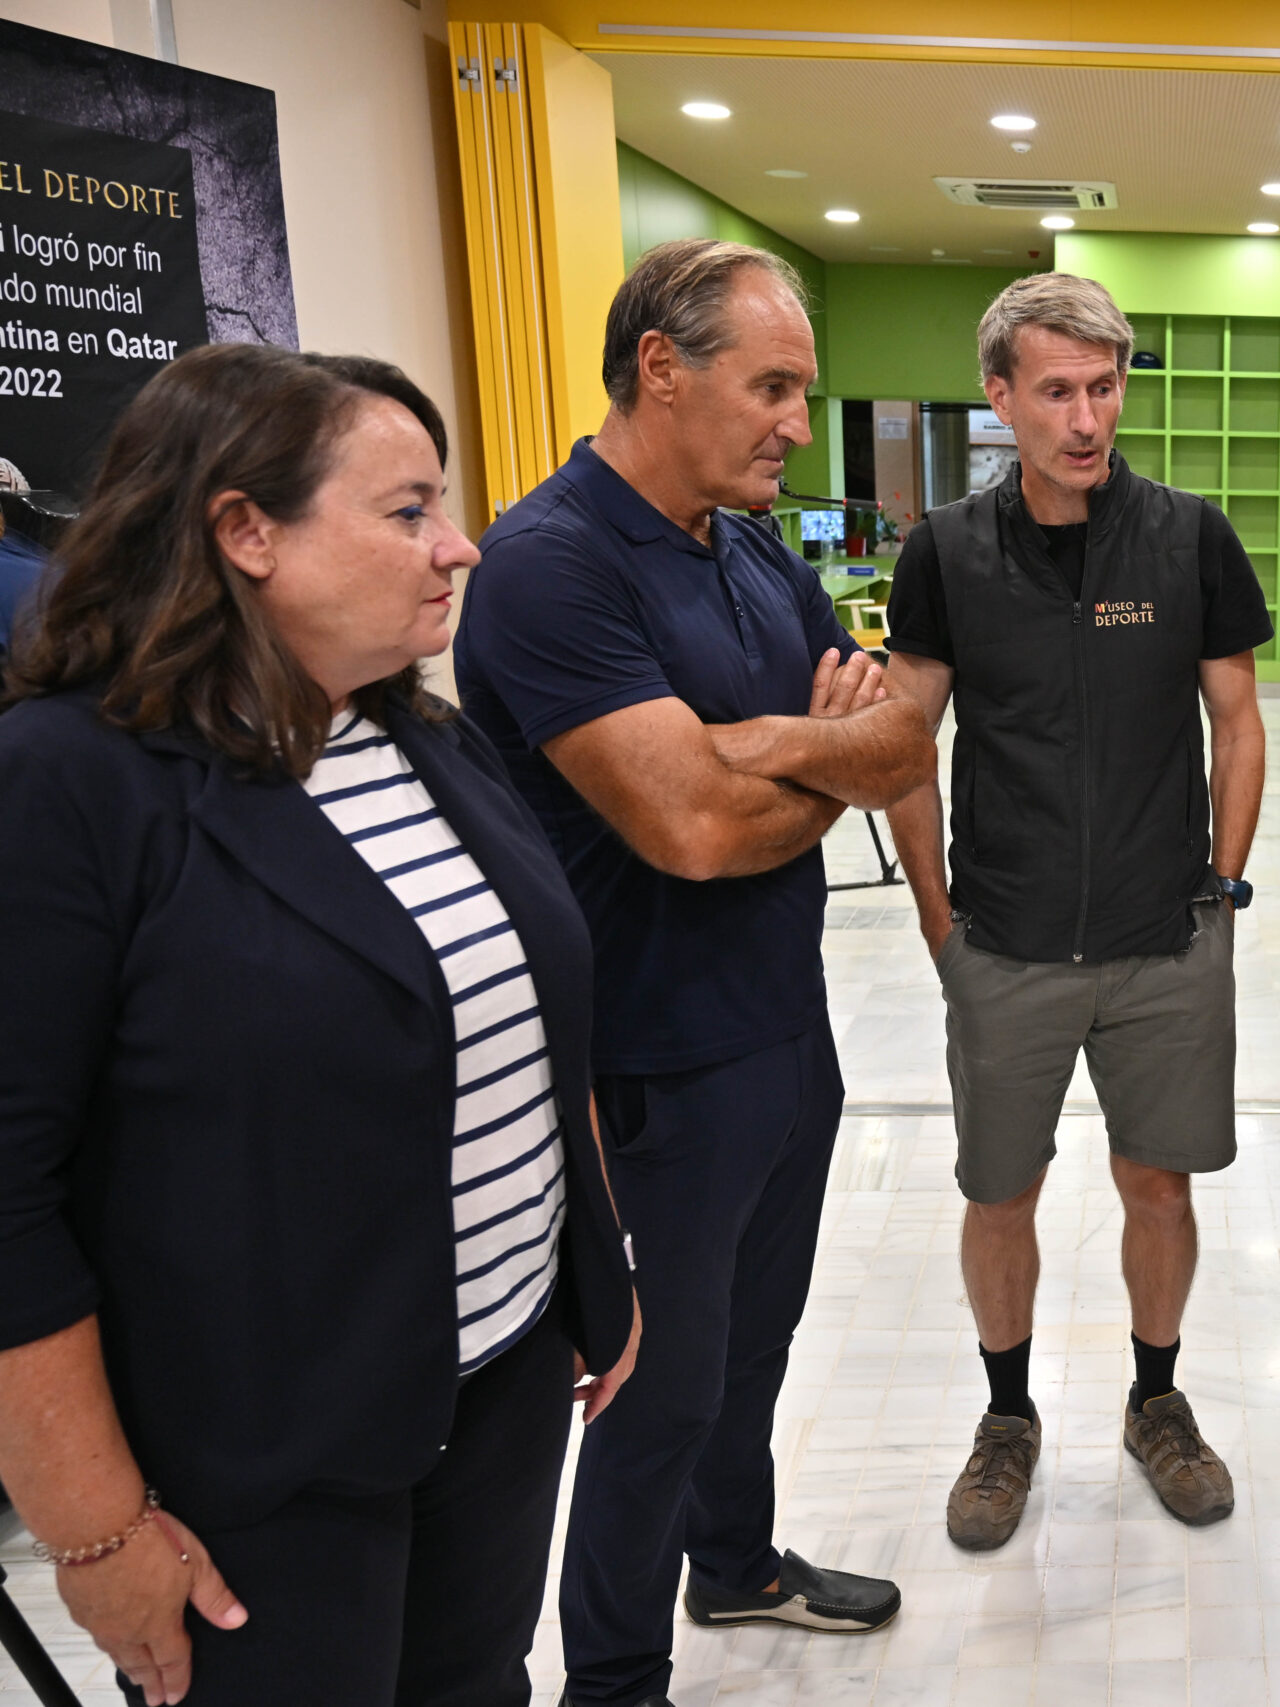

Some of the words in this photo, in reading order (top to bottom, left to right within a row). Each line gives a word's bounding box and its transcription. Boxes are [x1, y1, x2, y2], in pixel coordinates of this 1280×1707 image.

[43, 168, 183, 219] DEPORTE
[13, 224, 79, 266] logró
[87, 241, 126, 271] por
[133, 242, 162, 272] fin
[0, 272, 37, 304] do
[45, 280, 143, 315] mundial
[67, 331, 99, 355] en
[106, 328, 178, 360] Qatar
[0, 366, 63, 398] 2022
[1095, 600, 1135, 613] MUSEO
[1141, 602, 1154, 610] DEL
[1095, 611, 1155, 627] DEPORTE
